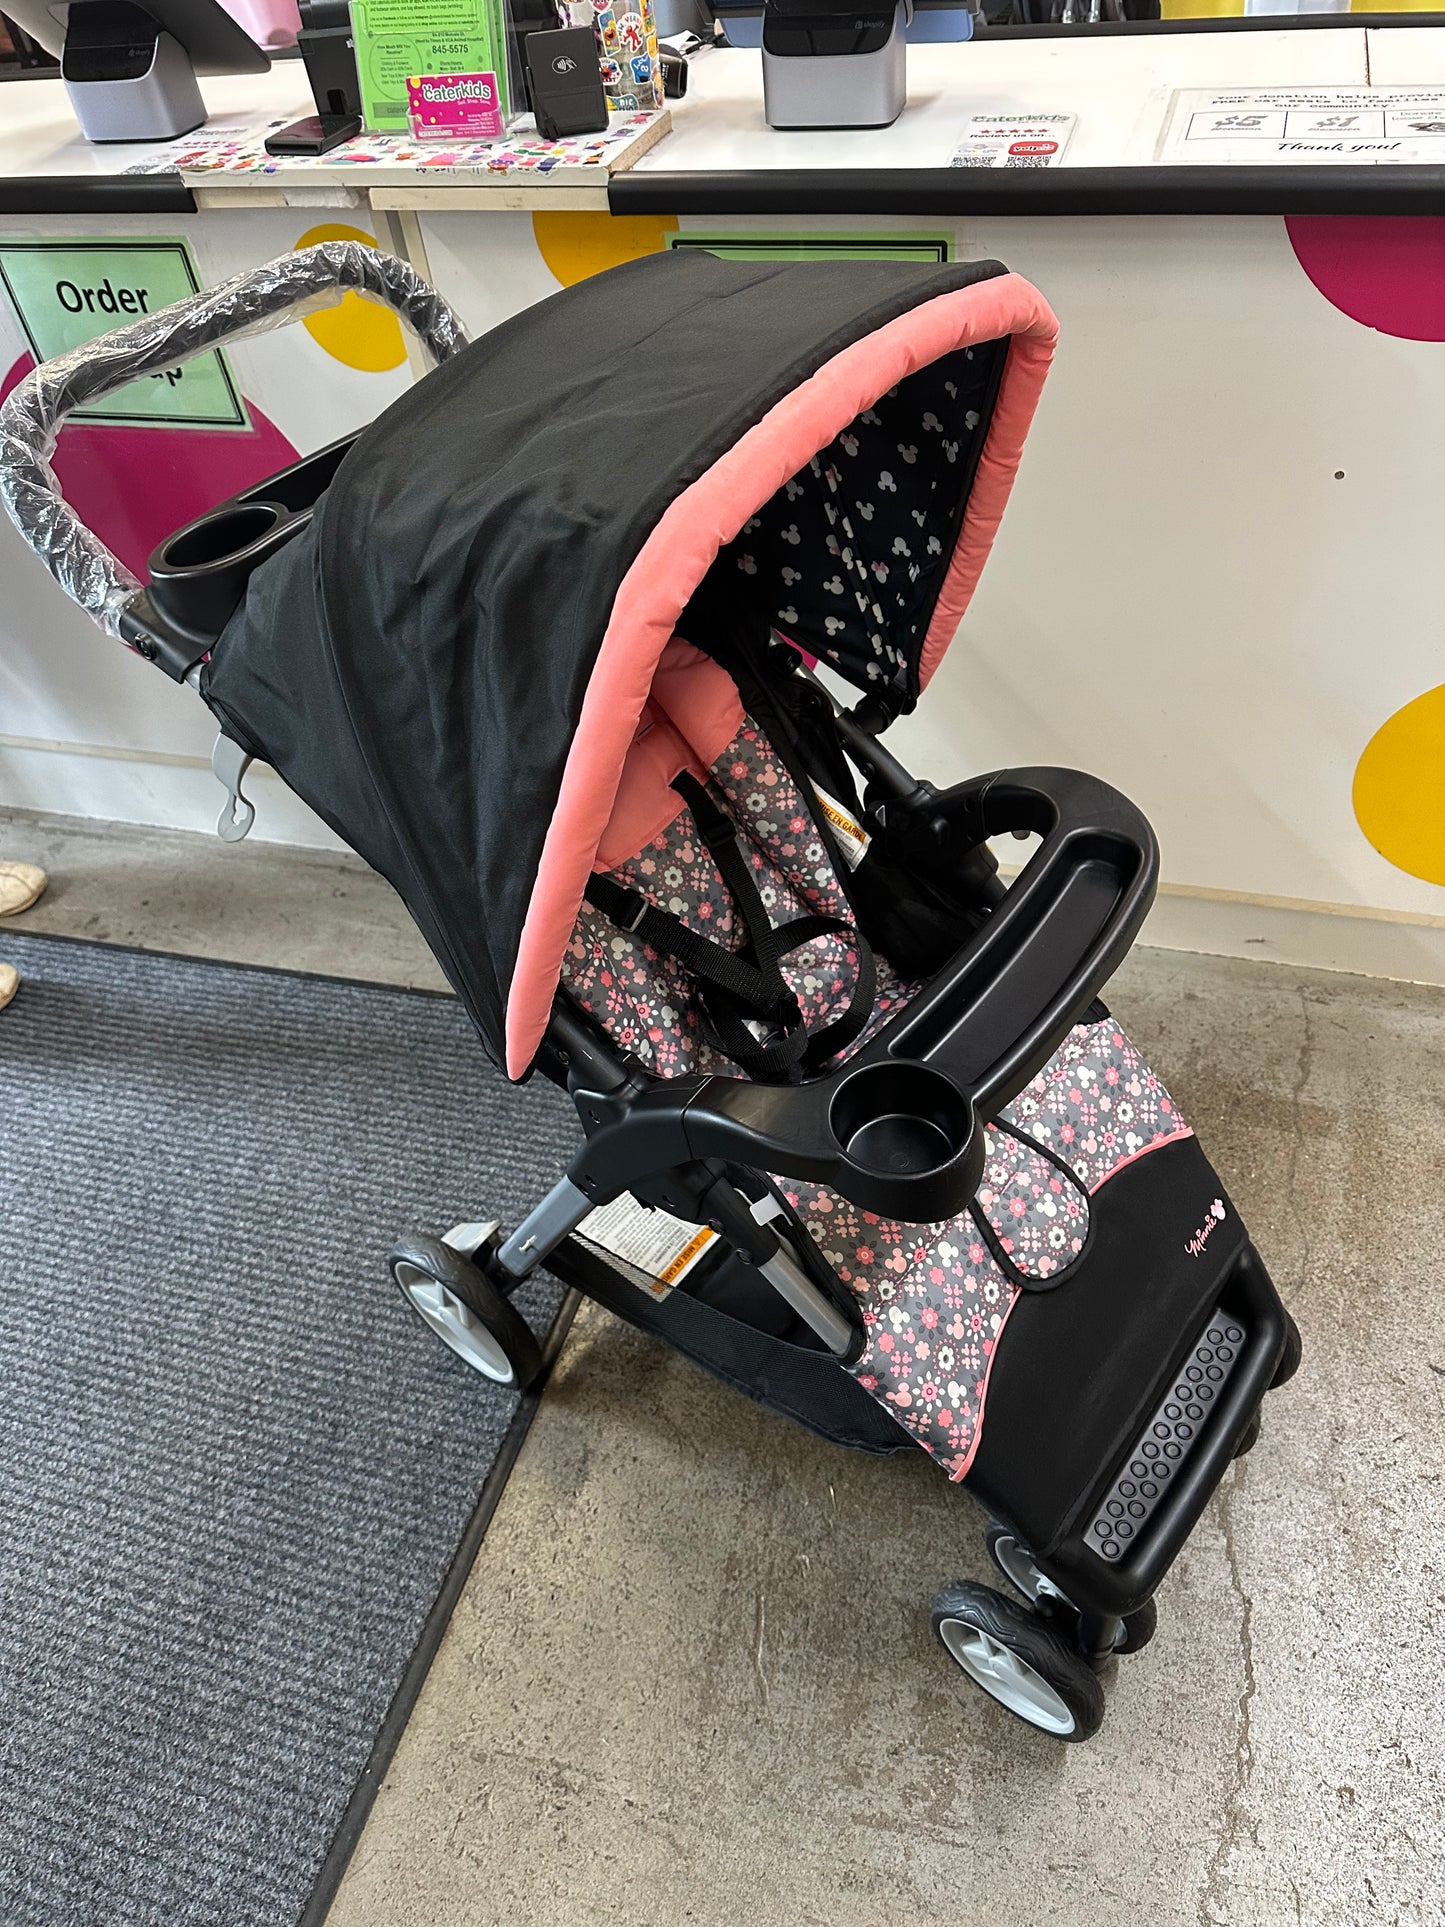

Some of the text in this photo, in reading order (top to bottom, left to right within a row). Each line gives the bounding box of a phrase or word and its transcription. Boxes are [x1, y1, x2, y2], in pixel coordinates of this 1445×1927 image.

[432, 44, 469, 54] 845-5575
[1213, 114, 1268, 128] $5
[1315, 115, 1360, 128] $1
[1278, 142, 1402, 153] Thank you!
[56, 278, 149, 314] Order
[832, 814, 843, 825] EN
[1184, 1214, 1217, 1257] Minnie
[681, 1245, 696, 1261] MISE
[674, 1258, 684, 1269] EN
